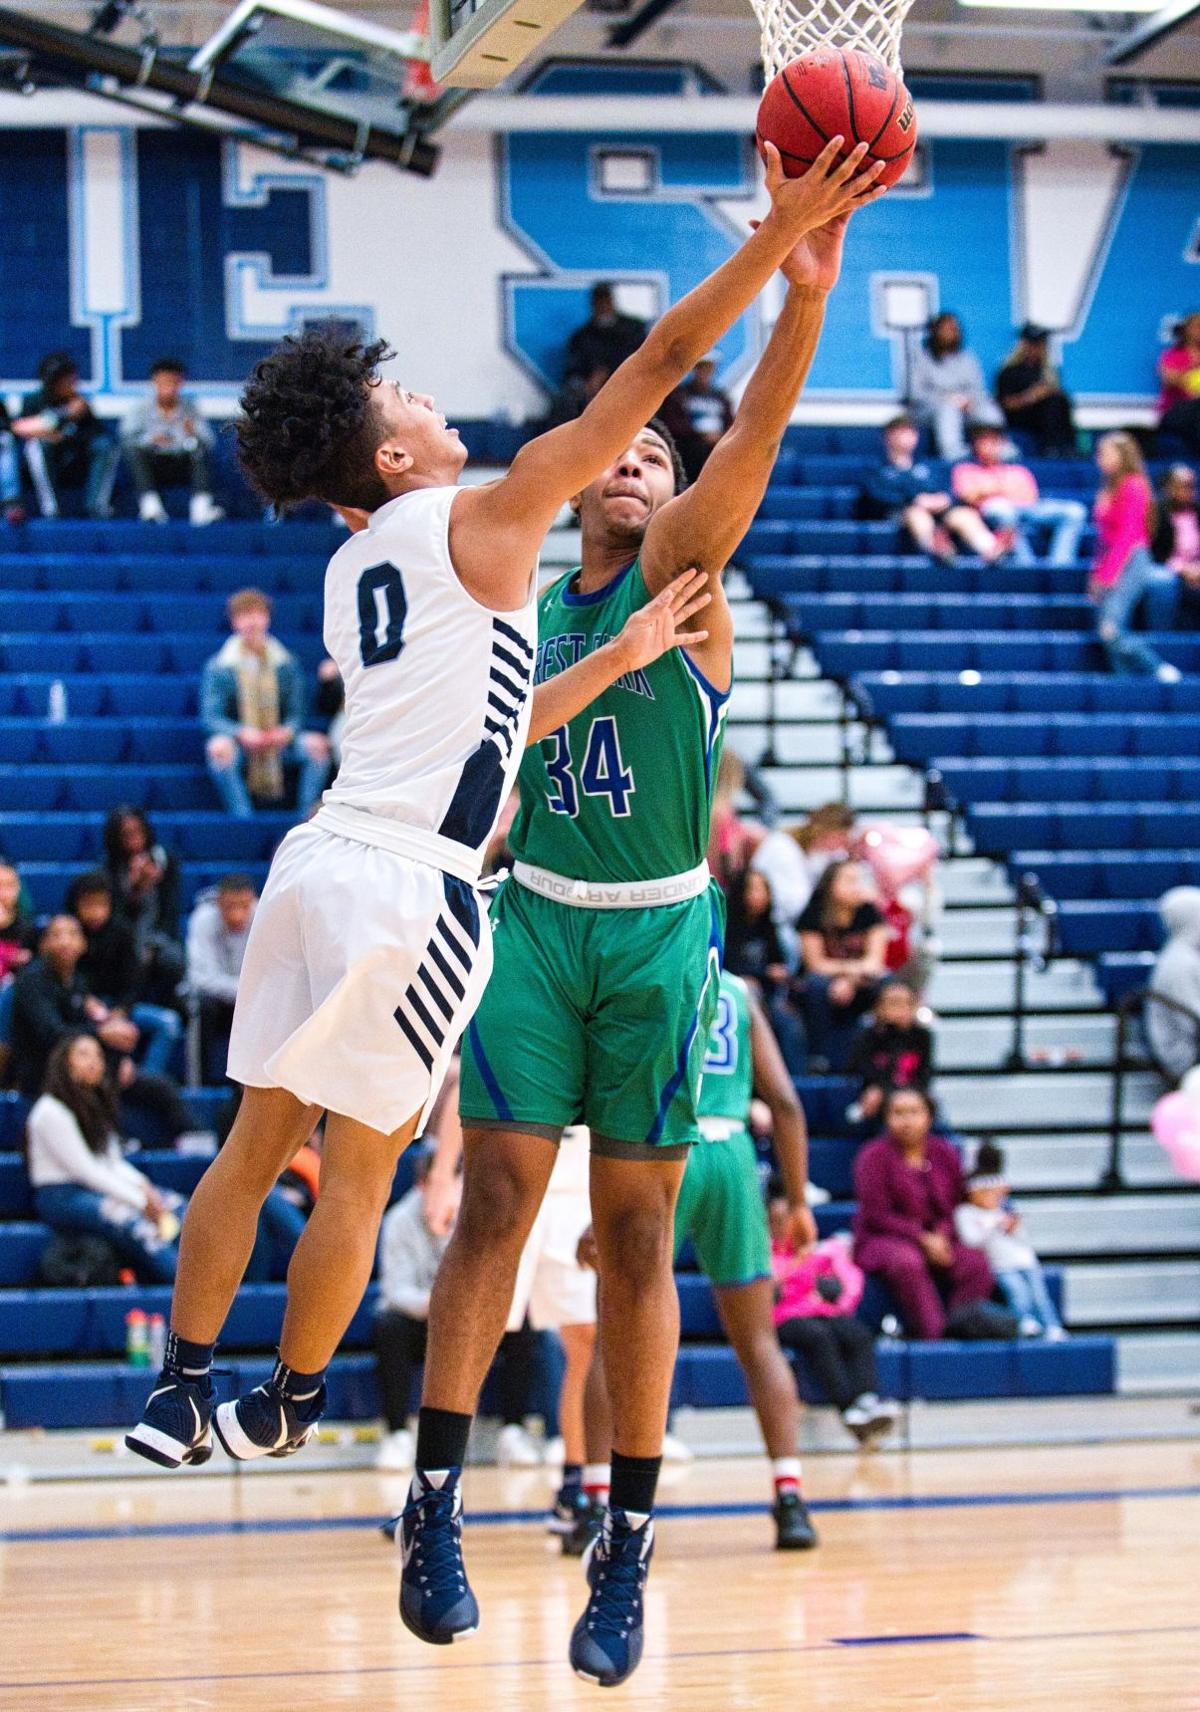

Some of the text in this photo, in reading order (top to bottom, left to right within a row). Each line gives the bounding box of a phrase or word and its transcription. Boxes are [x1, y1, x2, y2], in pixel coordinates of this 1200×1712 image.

[357, 560, 408, 669] 0
[536, 715, 636, 819] 34
[630, 877, 703, 903] UNDER
[702, 988, 739, 1076] 3
